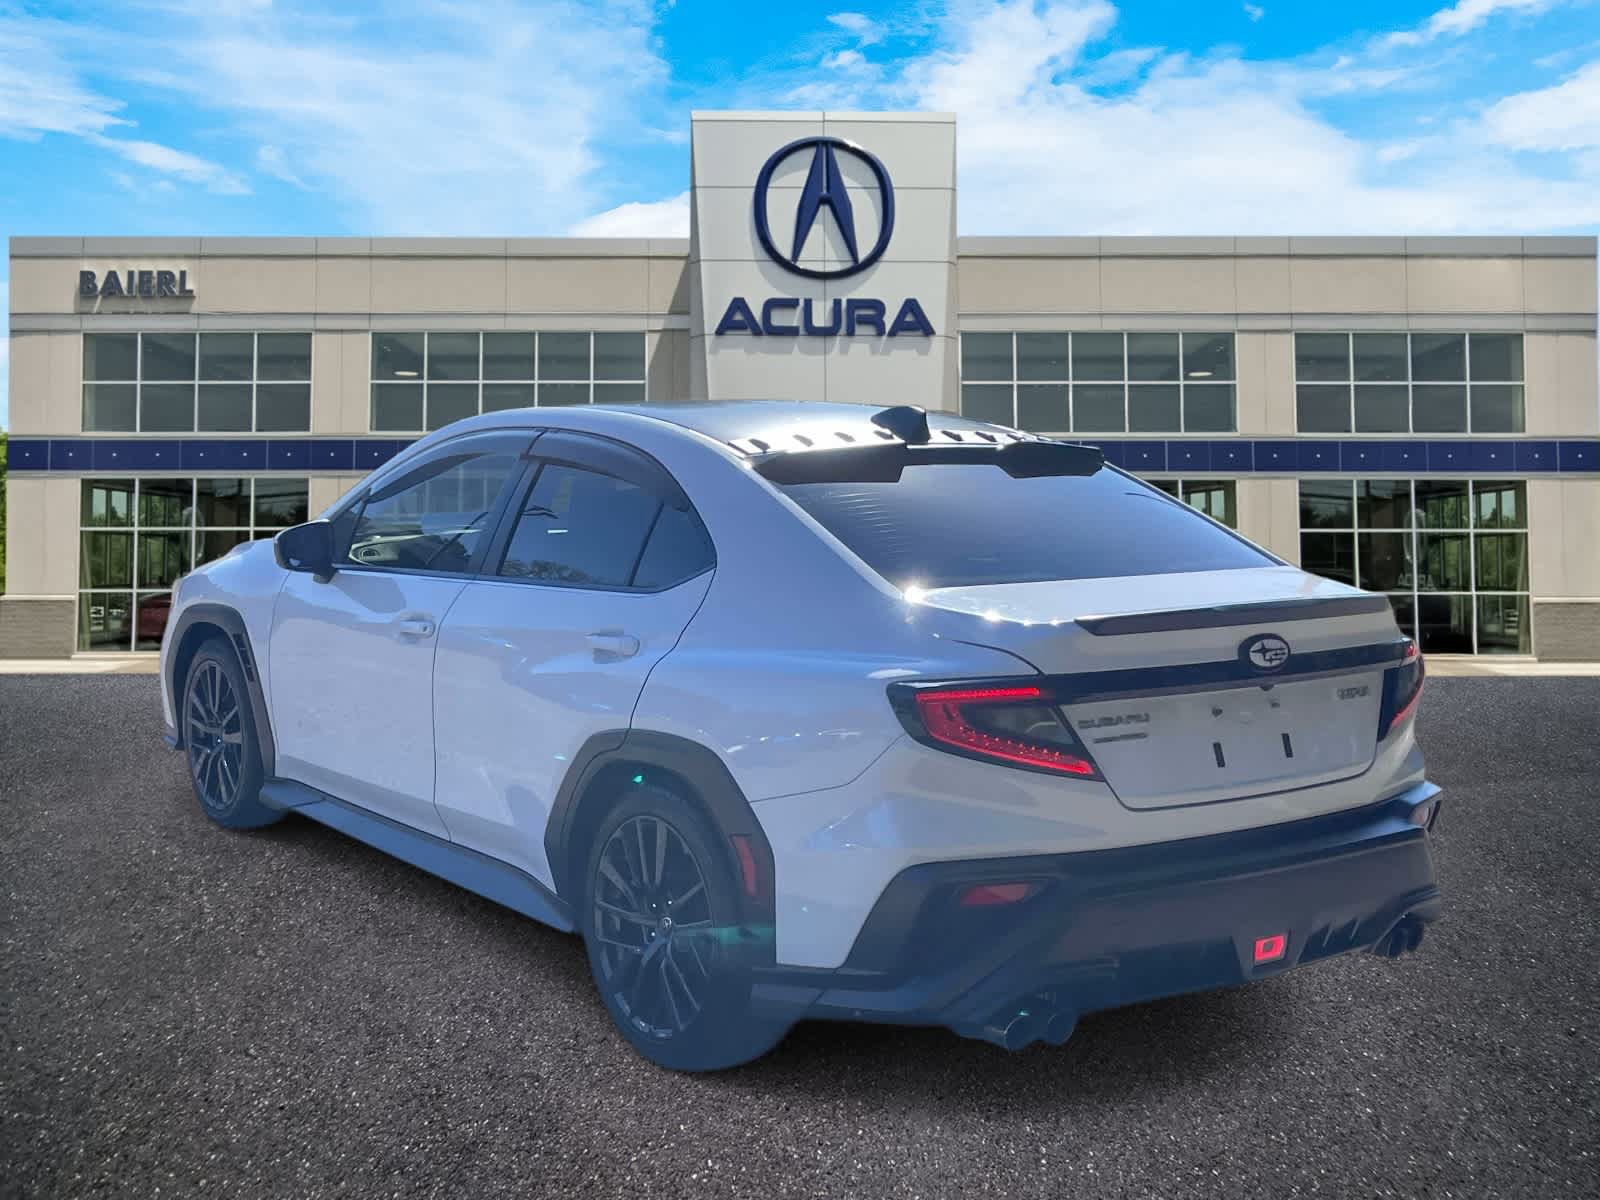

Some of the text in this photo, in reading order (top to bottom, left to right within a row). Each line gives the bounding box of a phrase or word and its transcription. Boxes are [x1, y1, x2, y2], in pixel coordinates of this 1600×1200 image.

[79, 269, 194, 297] BAIERL
[714, 296, 936, 337] ACURA
[1397, 573, 1435, 588] ACRA
